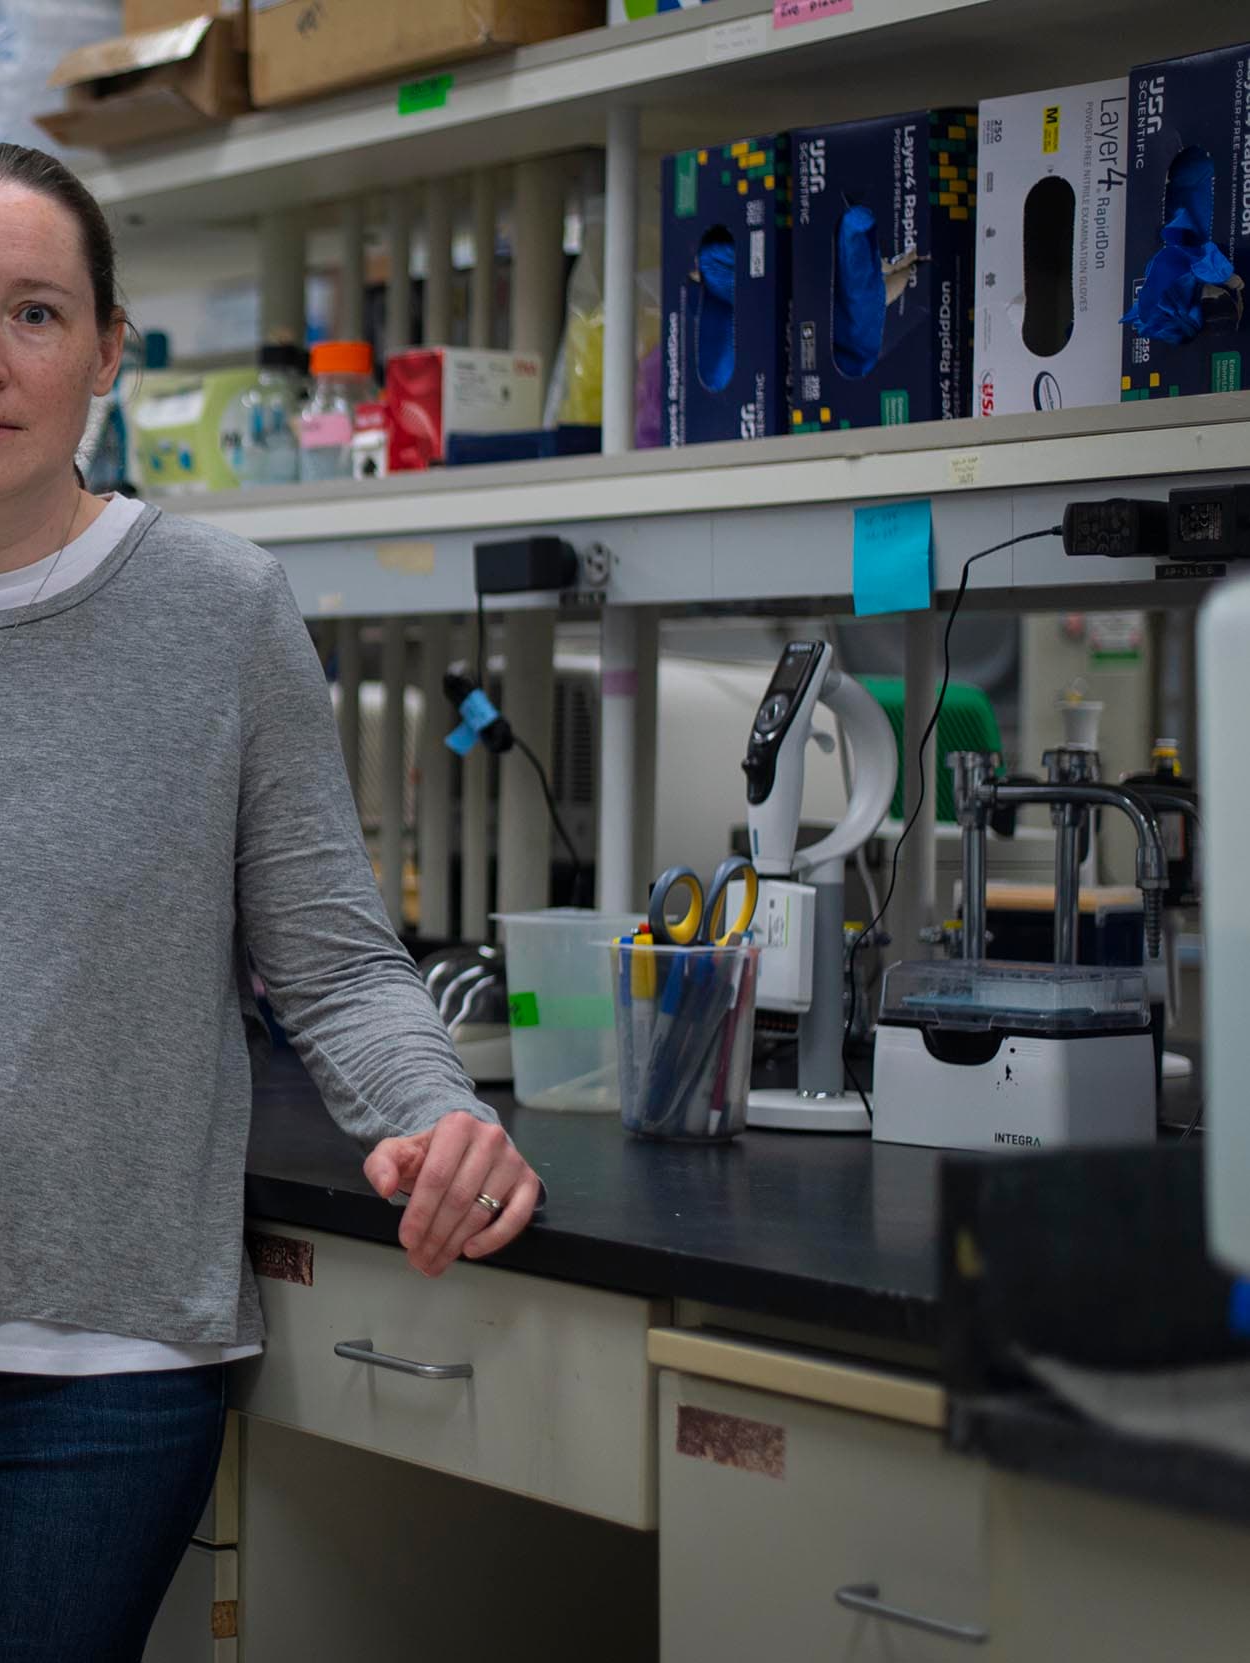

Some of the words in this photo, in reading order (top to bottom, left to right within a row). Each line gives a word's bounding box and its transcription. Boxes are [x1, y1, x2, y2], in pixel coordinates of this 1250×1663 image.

[1046, 108, 1058, 124] M
[1083, 102, 1093, 167] POWDER-FREE
[1135, 80, 1148, 169] SCIENTIFIC
[1233, 61, 1243, 150] POWDER-FREE
[902, 125, 916, 189] Layer4
[1094, 97, 1127, 191] Layer4
[799, 142, 809, 224] SCIENTIFIC
[1082, 170, 1091, 205] NITRILE
[902, 194, 918, 287] Rapidon
[1080, 208, 1088, 272] EXAMINATION
[1095, 197, 1109, 269] RapidDon
[939, 281, 952, 373] RapidDon
[1079, 276, 1088, 312] GLOVES
[994, 1132, 1041, 1148] INTEGRA
